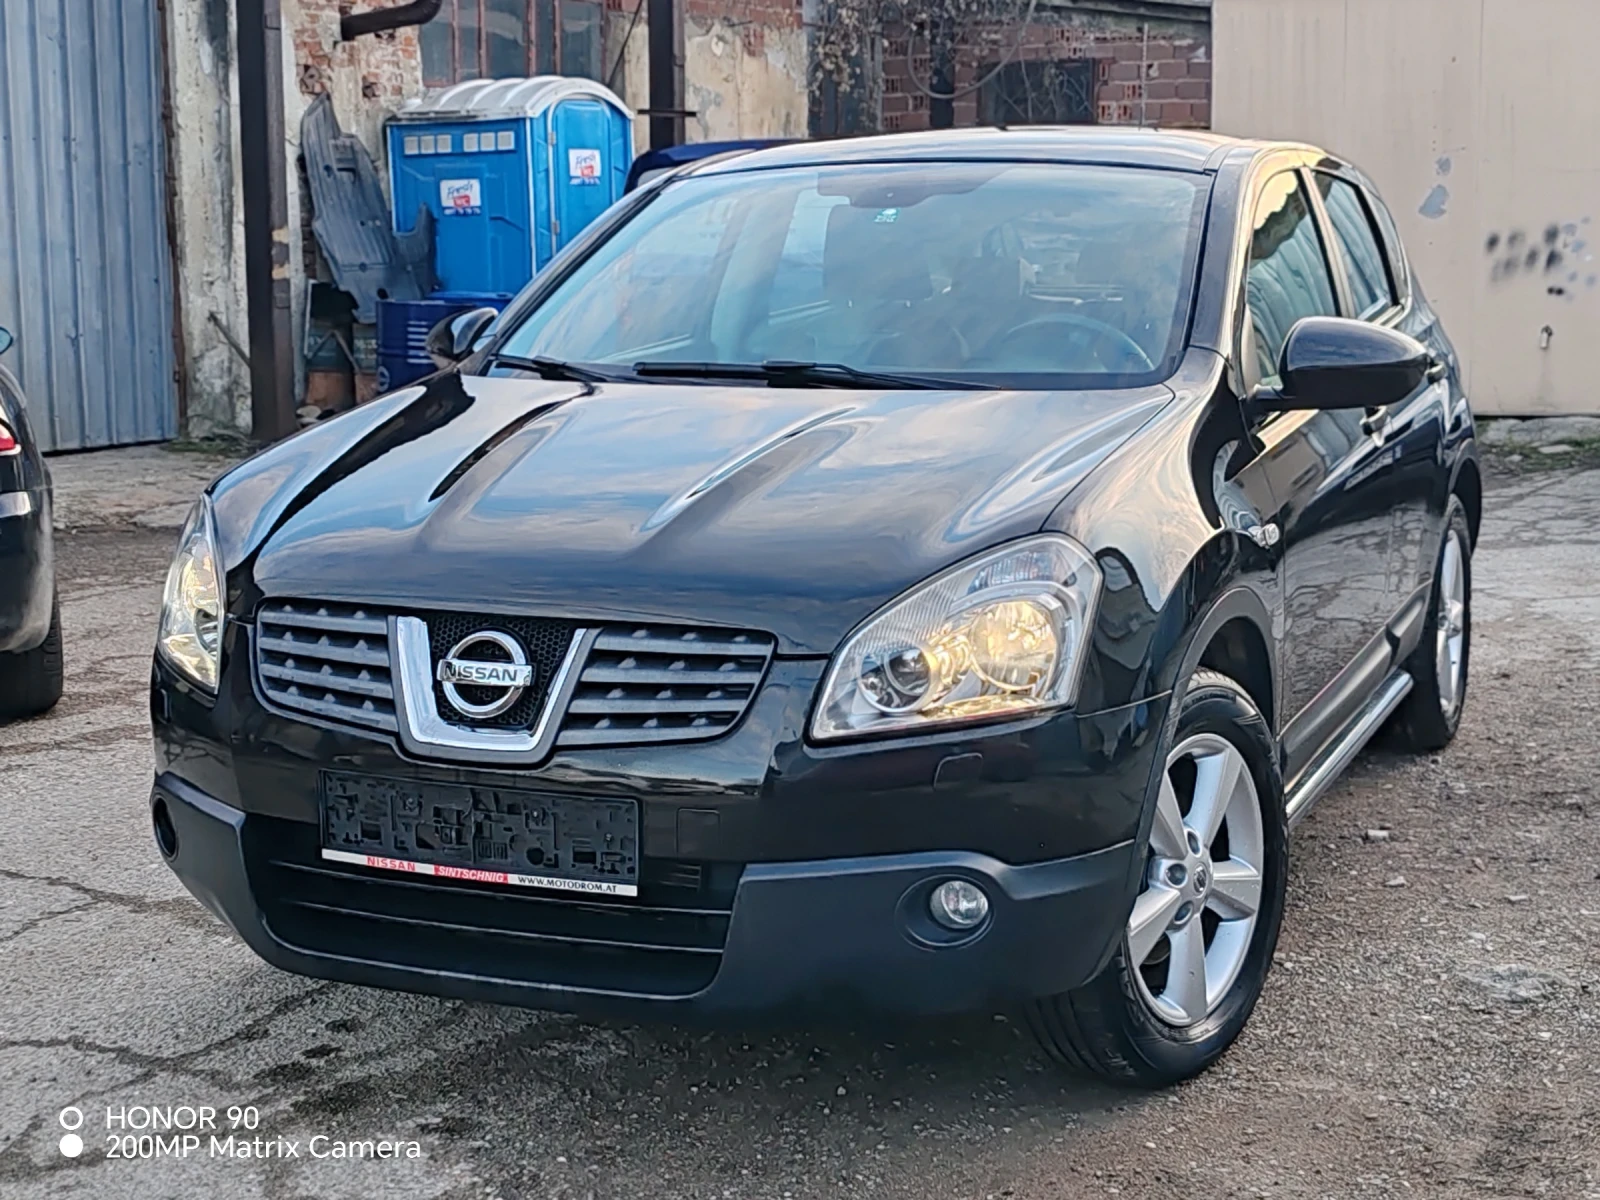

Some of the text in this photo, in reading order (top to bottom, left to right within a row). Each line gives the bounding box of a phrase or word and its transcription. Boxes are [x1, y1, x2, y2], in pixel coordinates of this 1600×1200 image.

[444, 661, 517, 682] NISSAN
[366, 856, 617, 893] NISSAN SINTSCHNIG WWW.MOTODROM.AT
